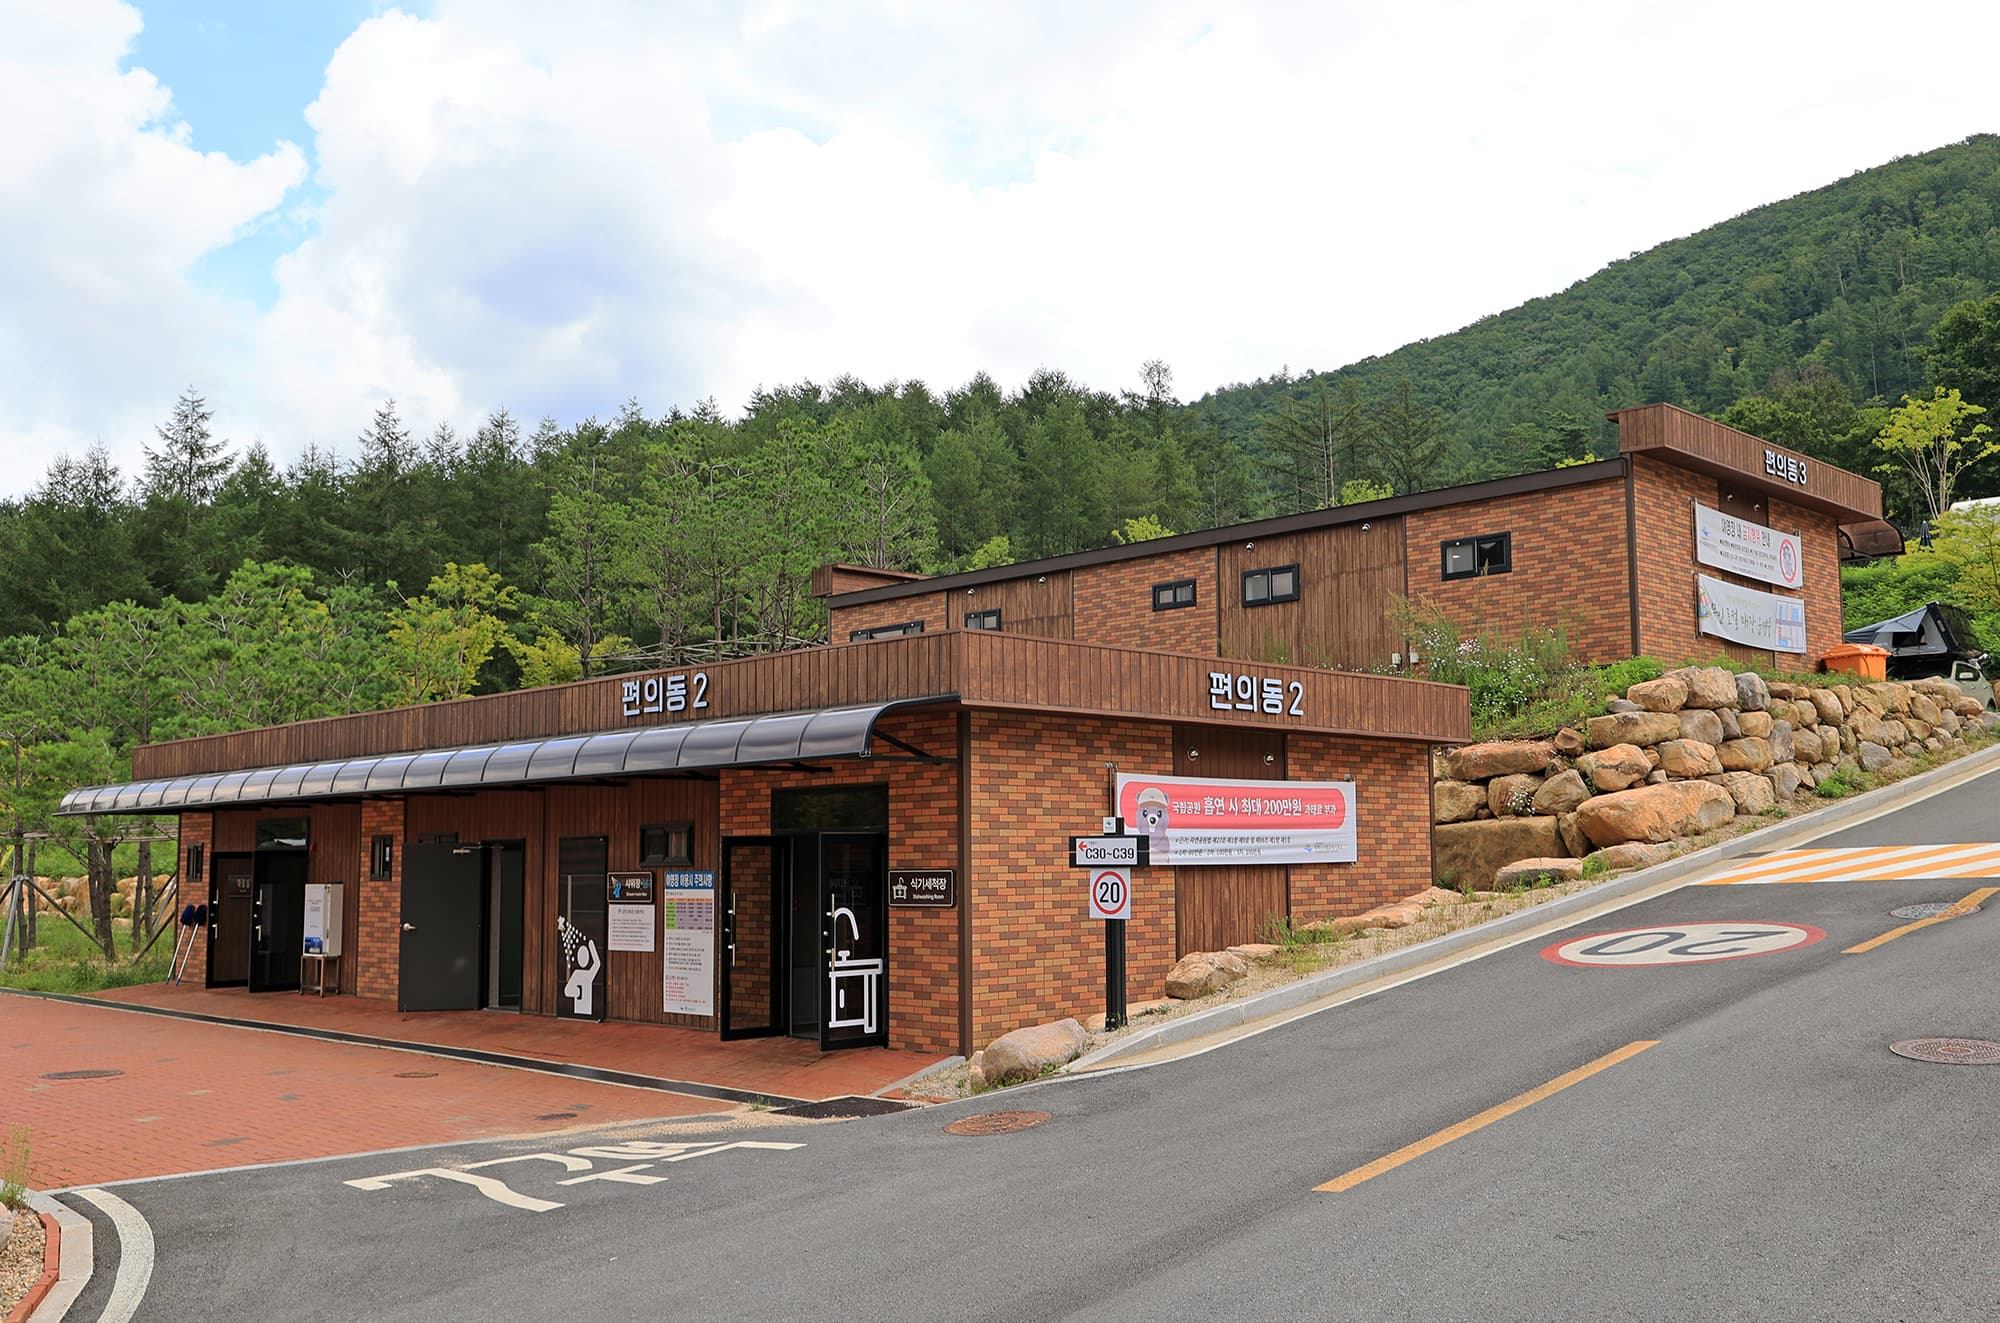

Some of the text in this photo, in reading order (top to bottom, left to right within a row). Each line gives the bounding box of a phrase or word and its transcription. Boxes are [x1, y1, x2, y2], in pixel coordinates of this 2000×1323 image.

[1763, 449, 1808, 485] 편의동 3
[621, 671, 709, 717] 편의동 2
[1208, 671, 1306, 717] 편의동 2
[1172, 796, 1337, 817] 국립공원 흡연 시 최대 200만원 과태료 부과
[1085, 847, 1135, 860] C30~C39
[911, 877, 947, 890] 식기세척장
[1099, 881, 1120, 904] 20
